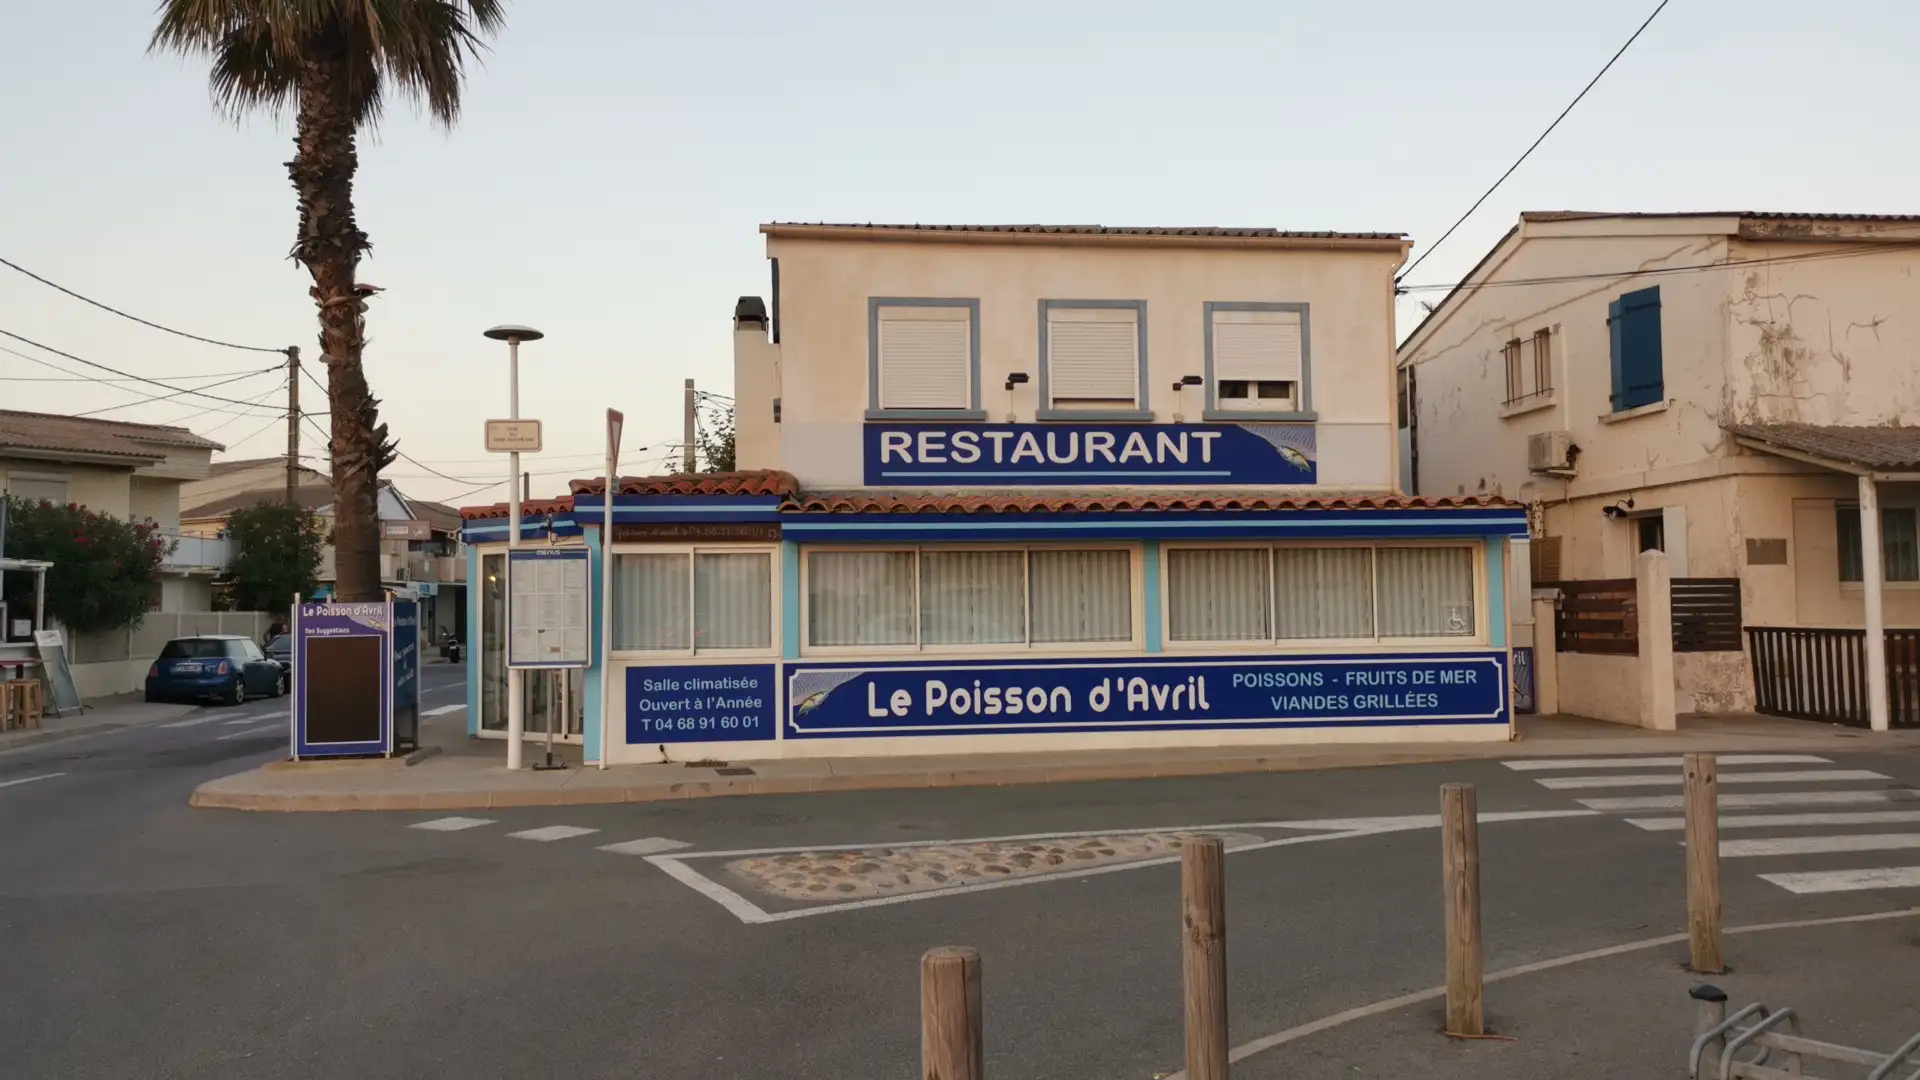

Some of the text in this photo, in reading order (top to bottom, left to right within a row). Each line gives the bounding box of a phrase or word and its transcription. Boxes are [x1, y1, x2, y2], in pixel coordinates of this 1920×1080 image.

[880, 430, 1222, 464] RESTAURANT
[303, 606, 315, 617] Le
[316, 605, 352, 617] Poisson
[643, 676, 758, 692] Salle climatisée
[1233, 672, 1324, 688] POISSONS
[1345, 670, 1408, 686] FRUITS
[1412, 670, 1436, 684] DE
[1440, 669, 1477, 684] MER
[639, 695, 762, 712] Ouvert à l'Année
[868, 676, 1210, 717] Le Poisson d'Avril
[1271, 691, 1439, 711] VIANDES GRILLÉES
[641, 715, 759, 731] T 04 68 91 60 01
